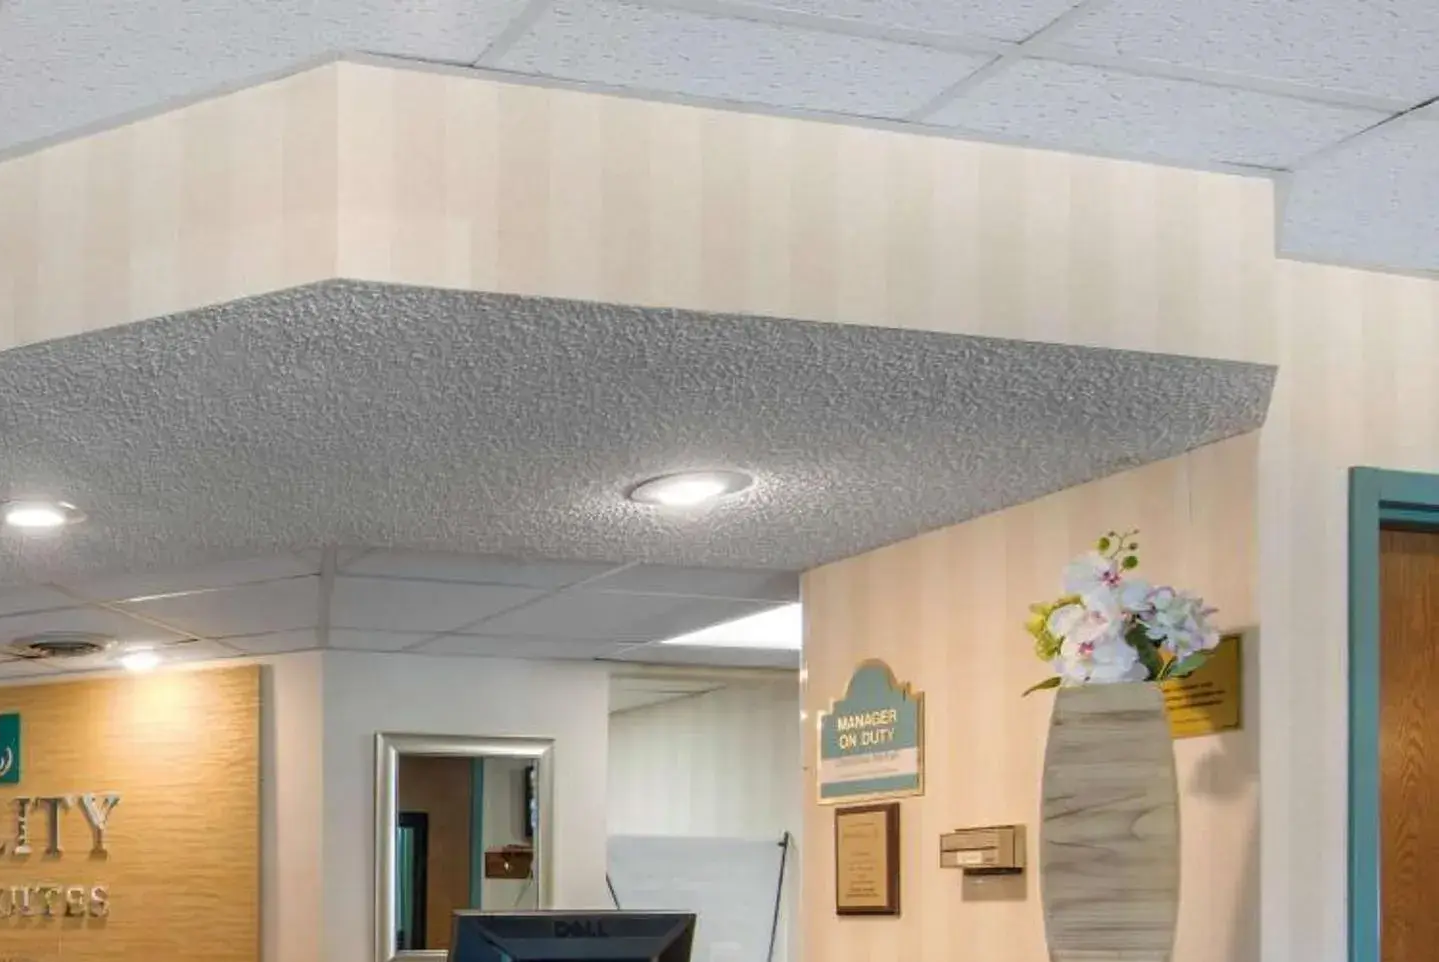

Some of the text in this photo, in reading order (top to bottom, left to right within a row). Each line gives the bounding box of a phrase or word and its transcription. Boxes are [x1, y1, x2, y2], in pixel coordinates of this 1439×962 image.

[837, 708, 897, 731] MANAGER
[839, 727, 895, 750] ON DUTY
[554, 920, 608, 938] DELL
